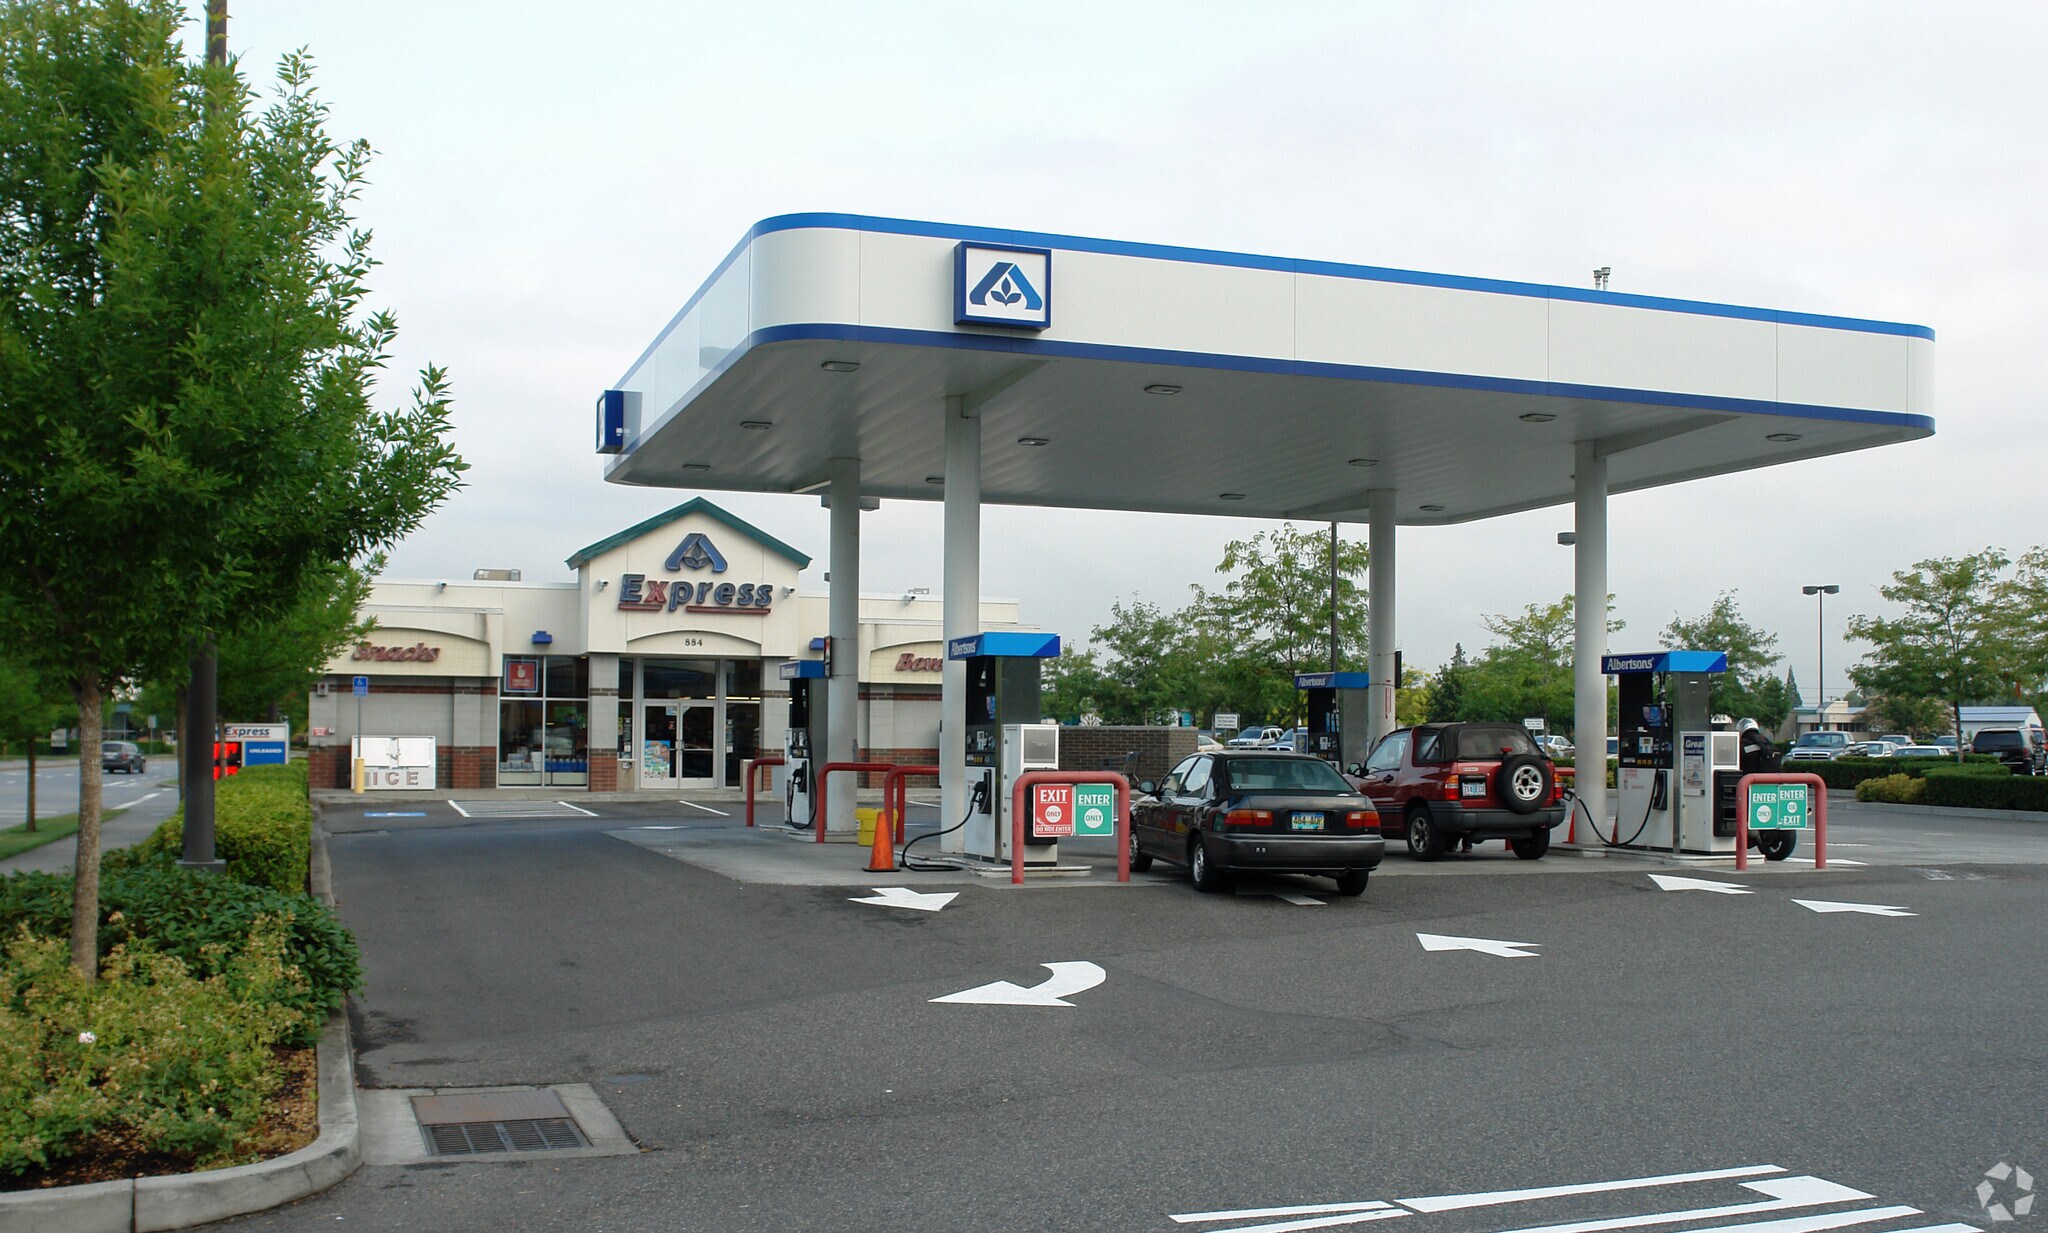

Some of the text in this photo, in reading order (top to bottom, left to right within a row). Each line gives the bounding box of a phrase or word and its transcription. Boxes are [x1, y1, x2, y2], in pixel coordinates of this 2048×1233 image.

[619, 574, 773, 612] Express
[684, 638, 703, 647] 884
[352, 642, 441, 662] Snacks
[1607, 657, 1653, 671] Albertsons
[1298, 677, 1326, 687] Albertsons
[224, 726, 270, 737] Express
[373, 771, 419, 786] ICE
[1040, 789, 1068, 802] EXIT
[1078, 794, 1110, 805] ENTER
[1752, 793, 1777, 802] ENTER
[1780, 790, 1805, 799] ENTER
[1085, 814, 1103, 822] ONLY
[1783, 815, 1801, 825] EXIT
